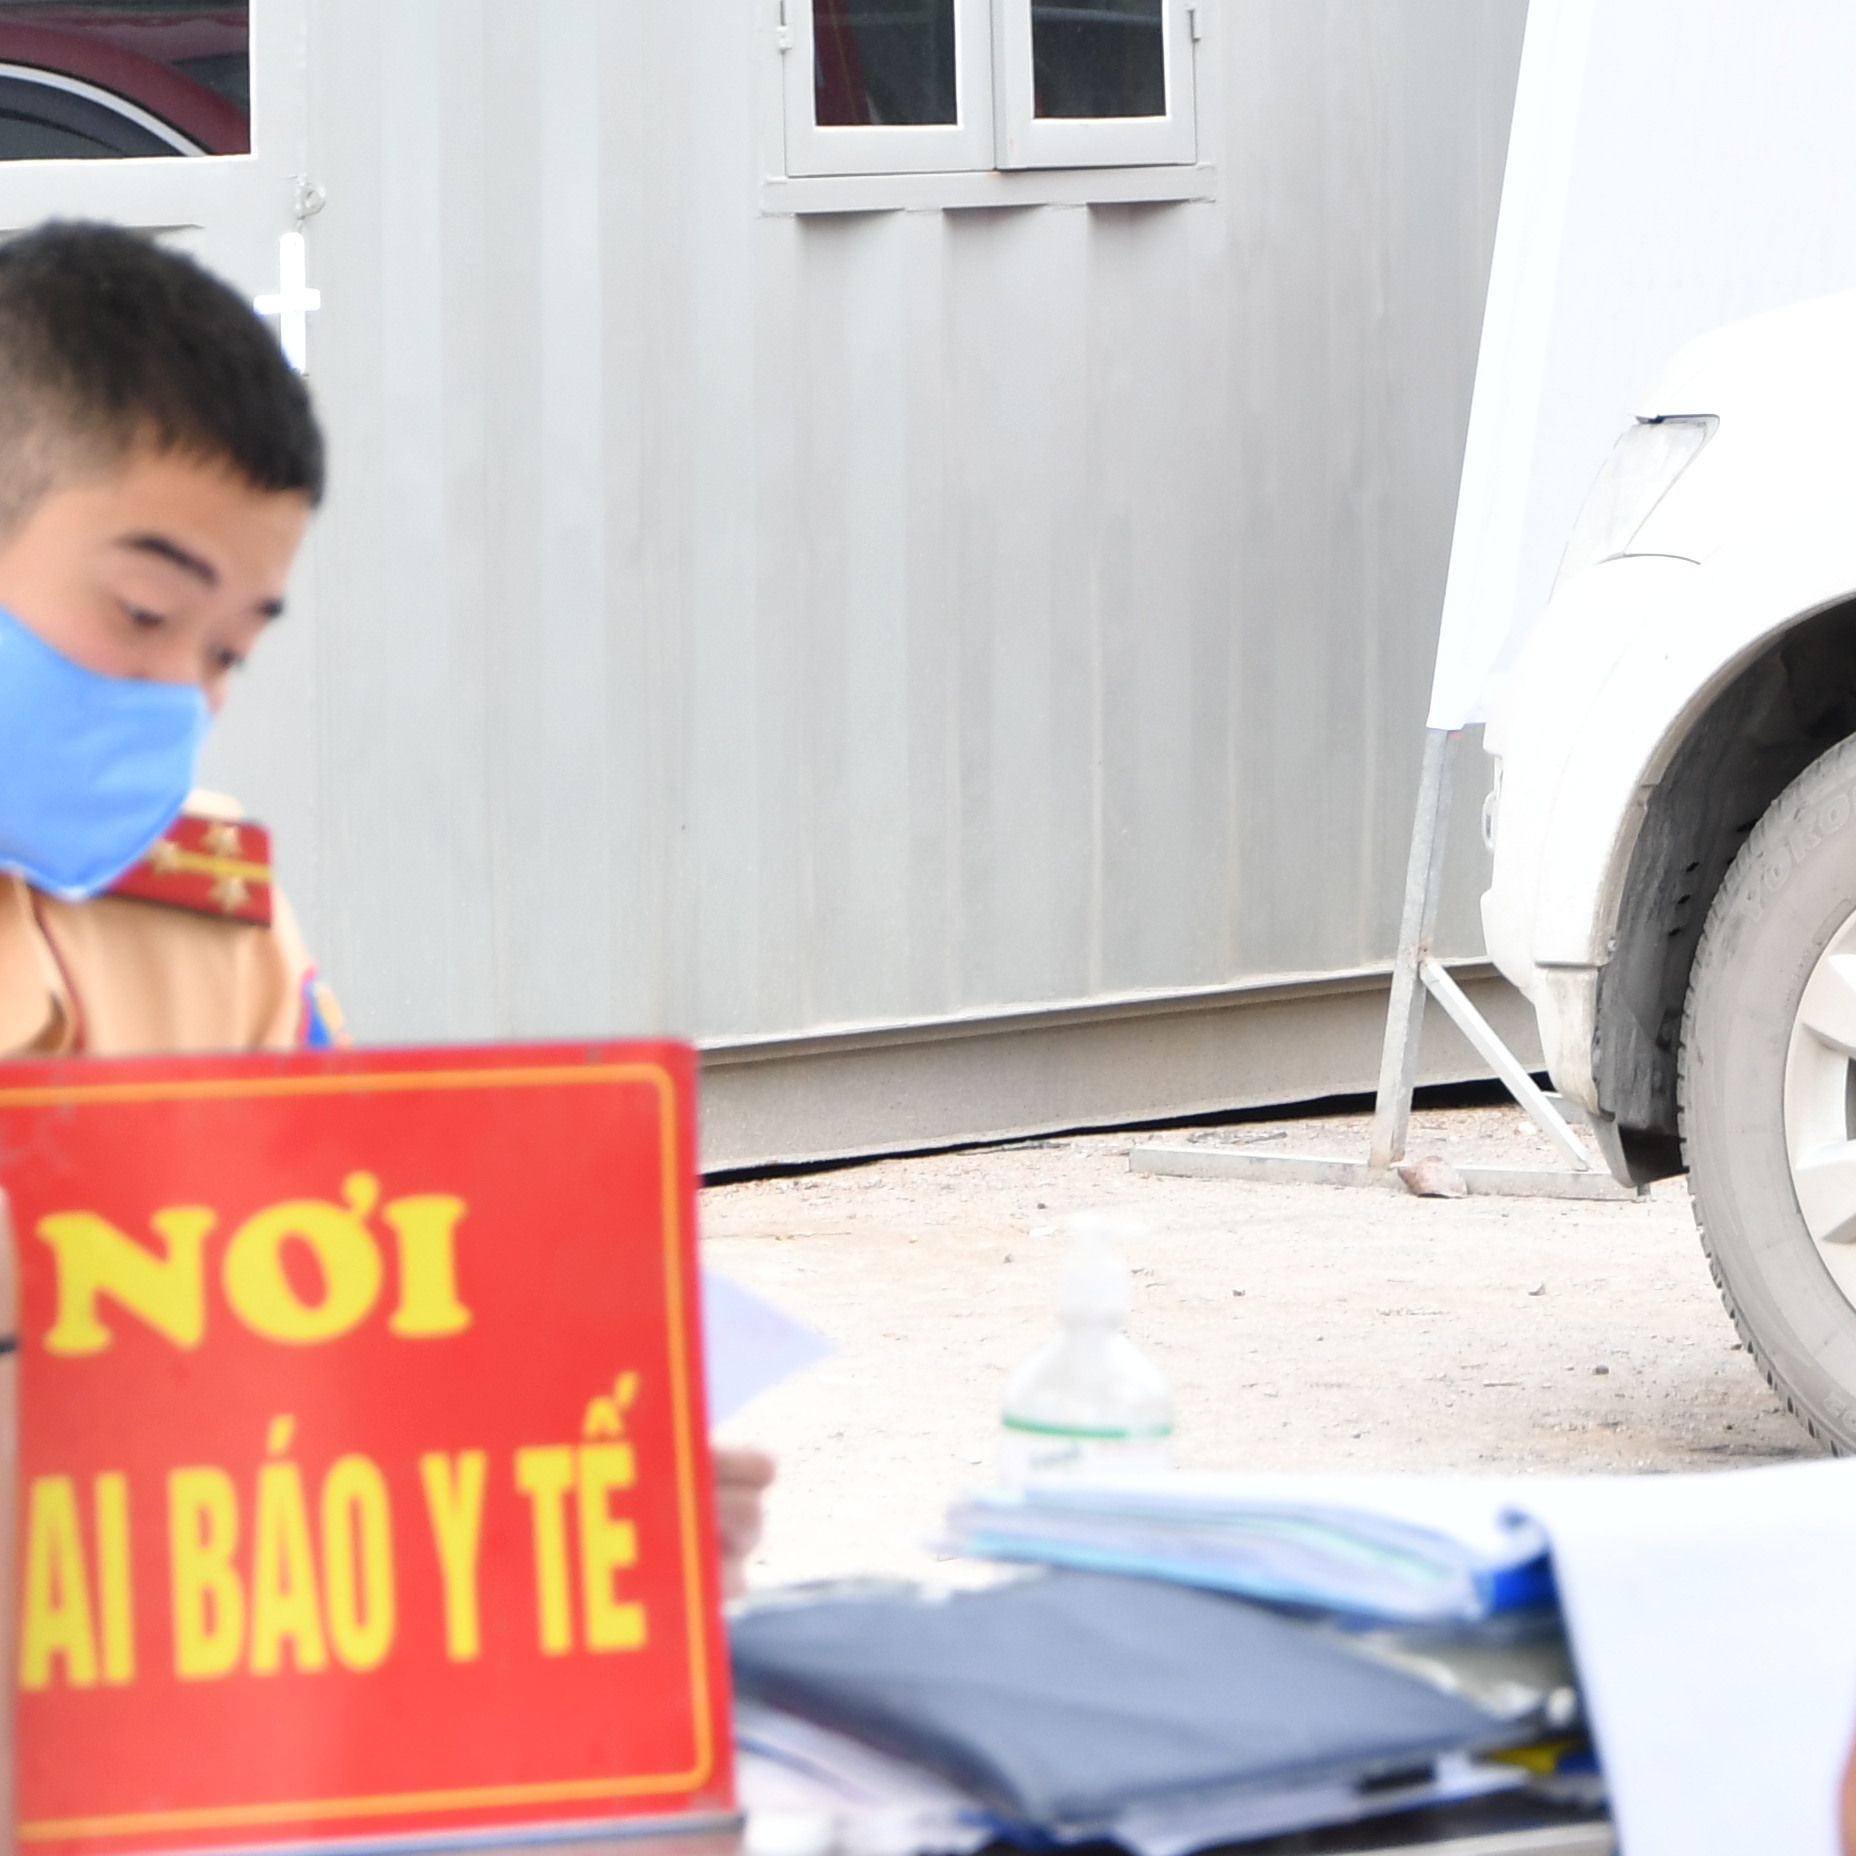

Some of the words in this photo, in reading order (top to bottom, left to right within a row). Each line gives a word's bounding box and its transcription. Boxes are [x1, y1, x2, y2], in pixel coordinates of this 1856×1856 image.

[37, 1169, 472, 1356] NƠI
[19, 1472, 135, 1692] AI
[167, 1414, 398, 1682] BÁO
[420, 1449, 488, 1663] Y
[514, 1371, 648, 1656] TẾ
